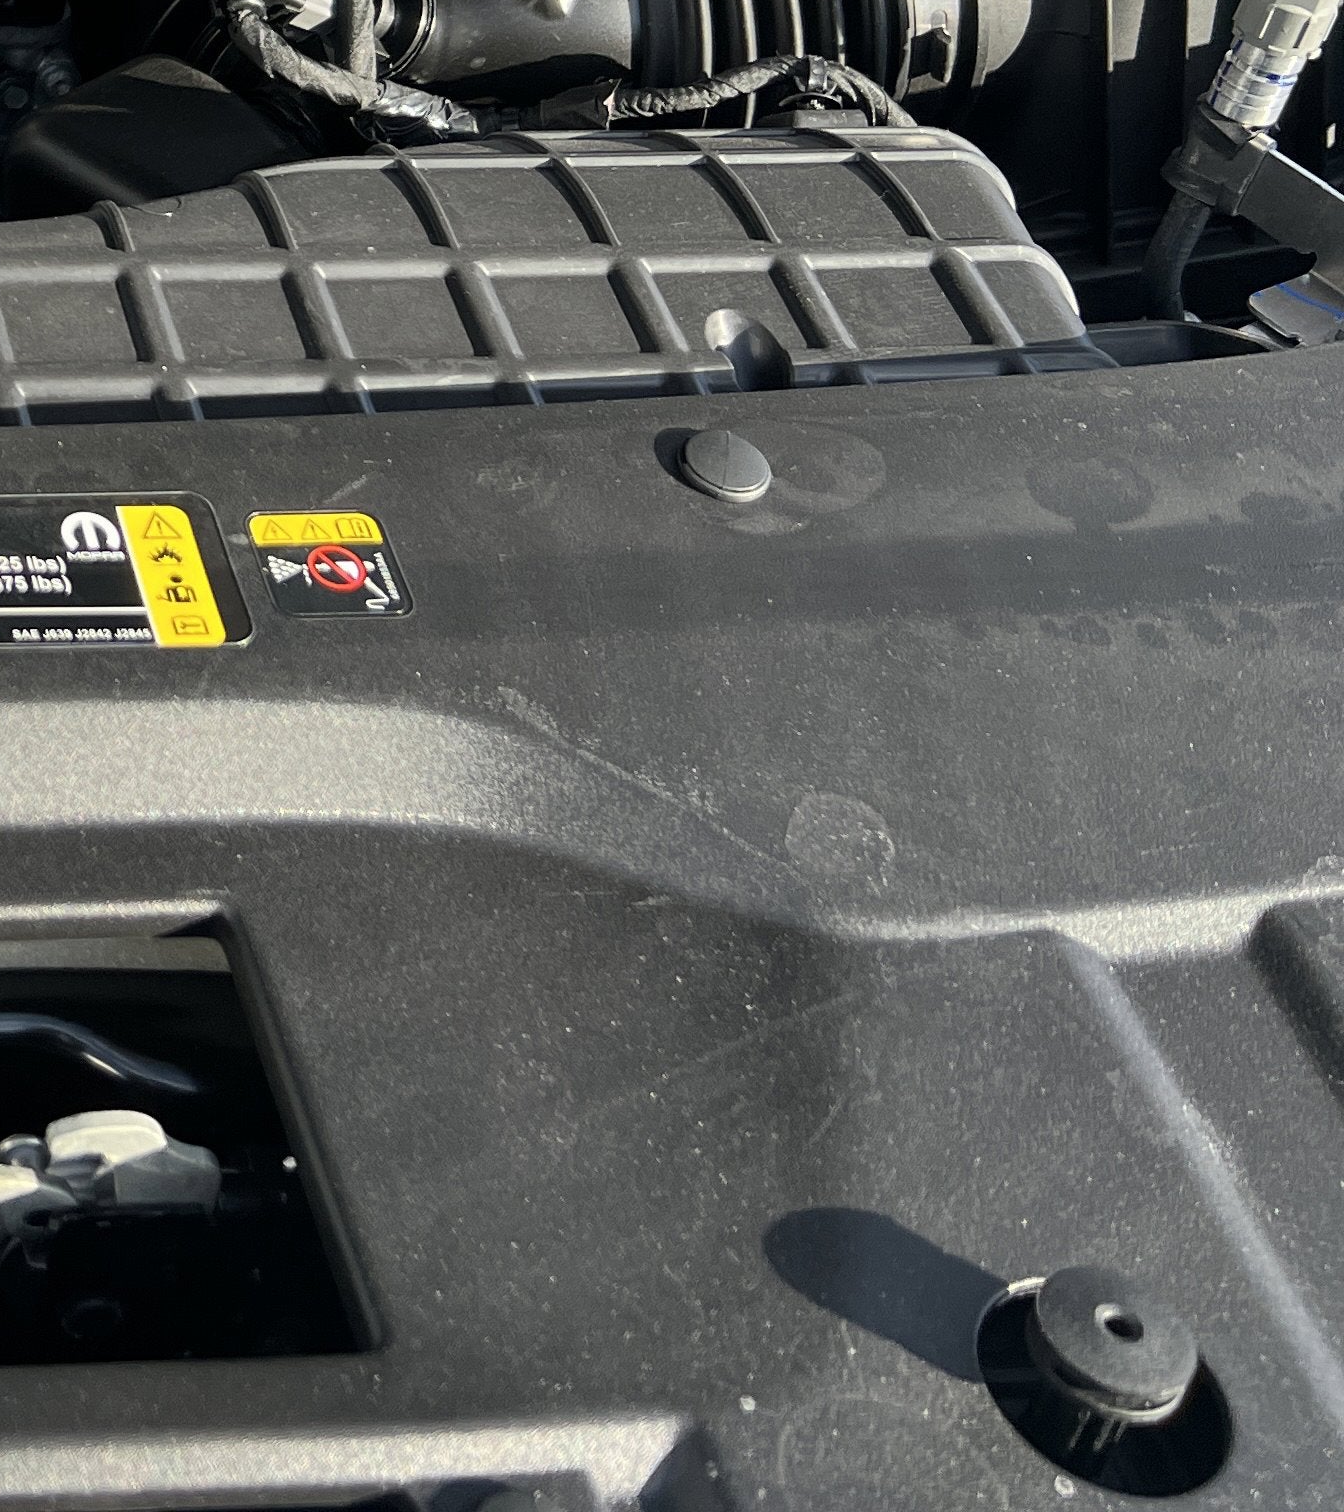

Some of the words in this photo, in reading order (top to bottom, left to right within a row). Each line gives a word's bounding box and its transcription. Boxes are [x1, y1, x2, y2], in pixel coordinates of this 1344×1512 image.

[27, 554, 68, 575] lbs)
[66, 550, 126, 562] MOPAR
[32, 573, 73, 595] lbs)
[12, 628, 40, 641] SAE
[42, 628, 74, 641] J639
[75, 628, 113, 641] J2842
[114, 627, 153, 640] J2845
